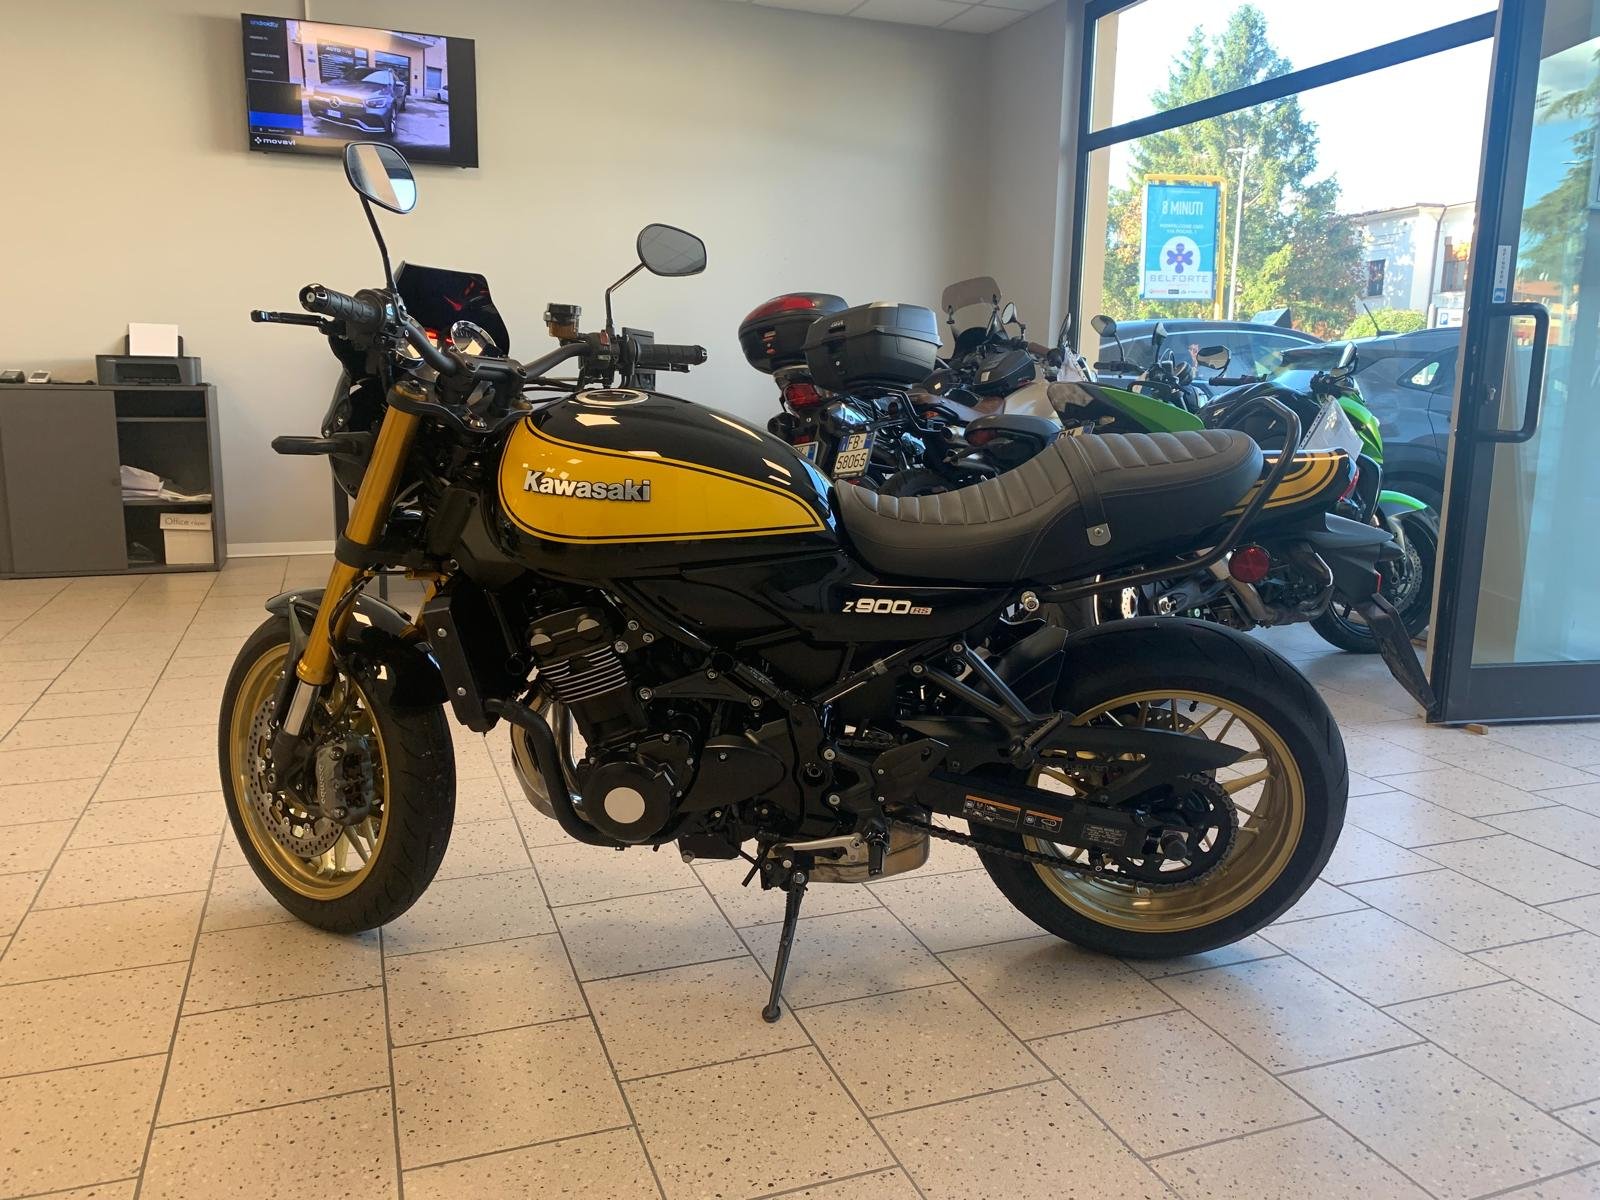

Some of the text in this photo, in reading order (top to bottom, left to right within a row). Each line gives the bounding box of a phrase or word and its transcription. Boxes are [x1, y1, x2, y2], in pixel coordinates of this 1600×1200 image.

[263, 138, 296, 146] movavi
[1161, 200, 1204, 216] 8 MINUTI
[1150, 274, 1209, 283] BELFORTE
[836, 452, 867, 470] 58065
[523, 469, 651, 503] Kawasaki
